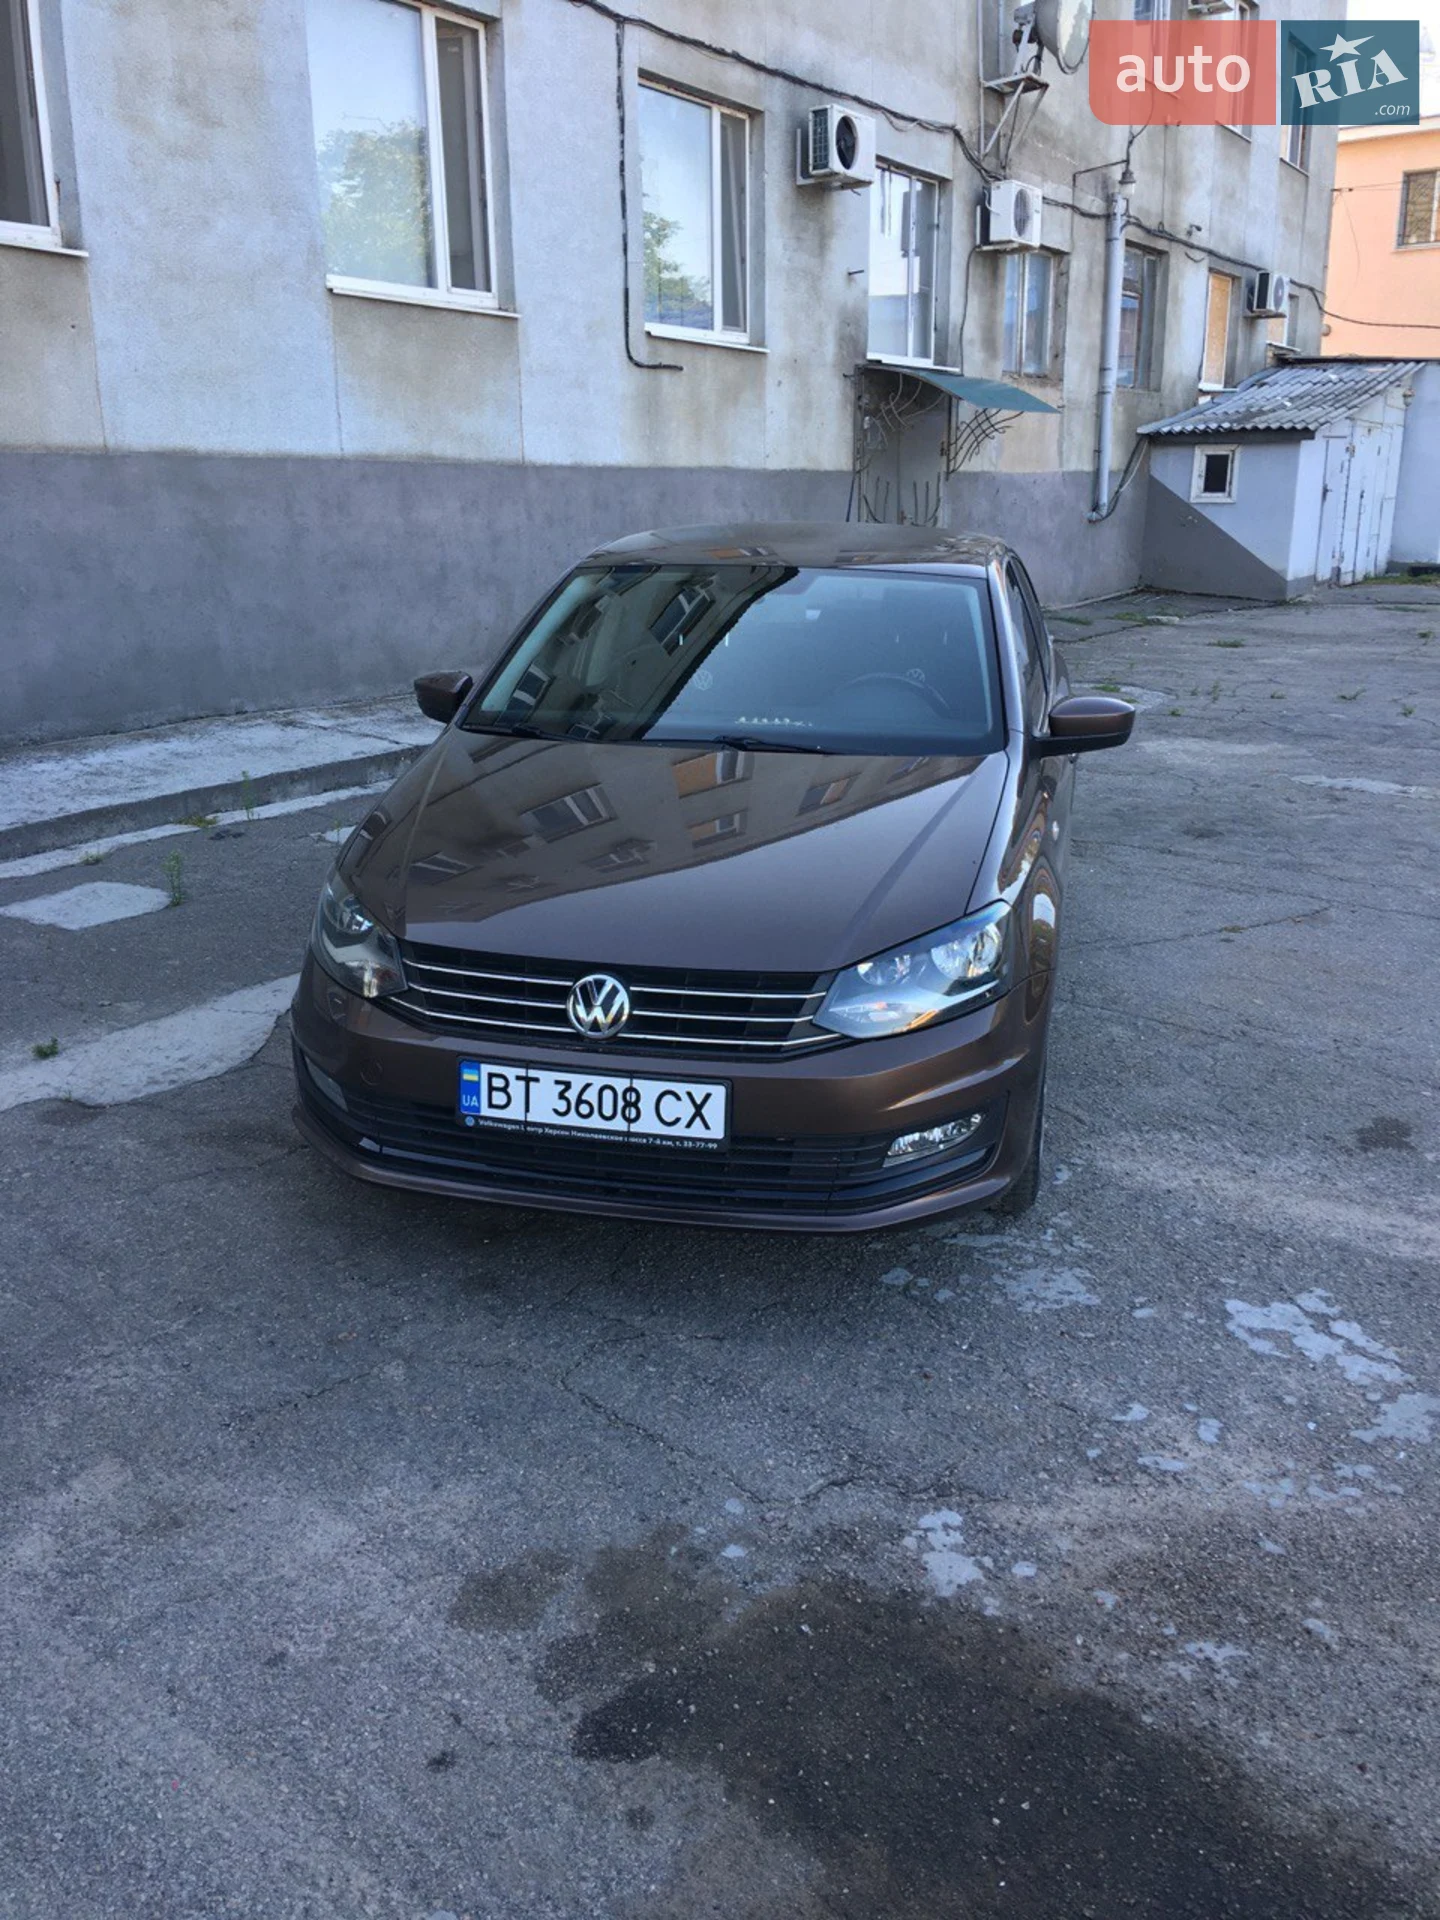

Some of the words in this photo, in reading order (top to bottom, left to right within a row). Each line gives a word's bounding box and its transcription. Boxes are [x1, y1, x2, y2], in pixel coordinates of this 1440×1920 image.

[567, 974, 629, 1039] VW
[462, 1094, 479, 1107] UA
[486, 1072, 541, 1113] BT
[551, 1079, 642, 1124] 3608
[654, 1089, 713, 1131] CX
[478, 1119, 520, 1131] Volkswagen
